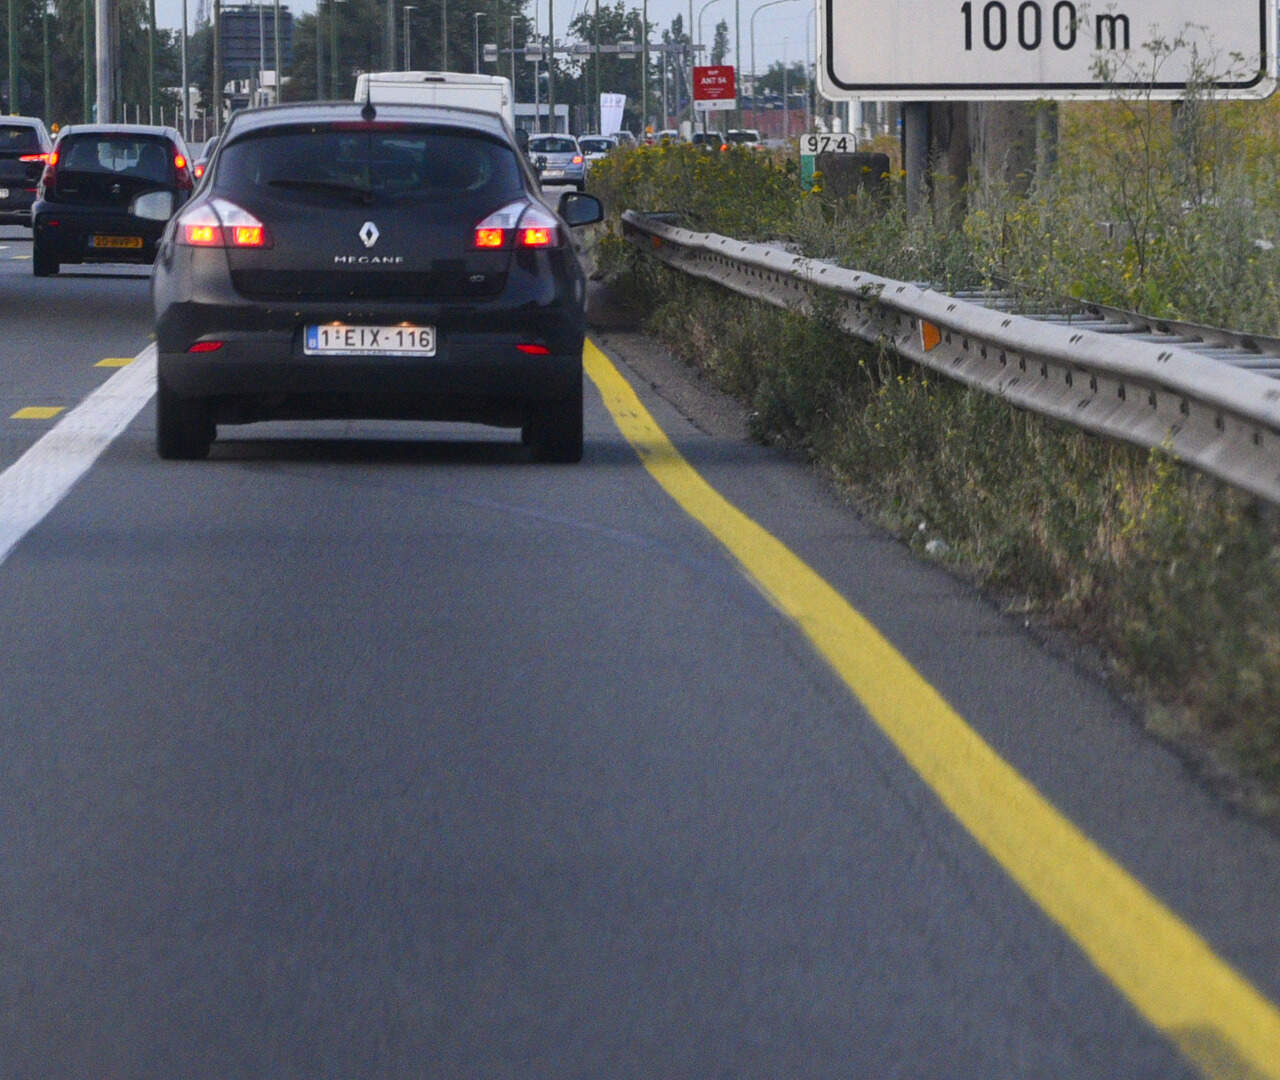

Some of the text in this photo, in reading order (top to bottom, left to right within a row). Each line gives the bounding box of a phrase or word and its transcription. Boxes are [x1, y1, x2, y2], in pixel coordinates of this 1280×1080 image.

[960, 0, 1131, 51] 1000 m
[321, 328, 431, 349] 1-EIX-116
